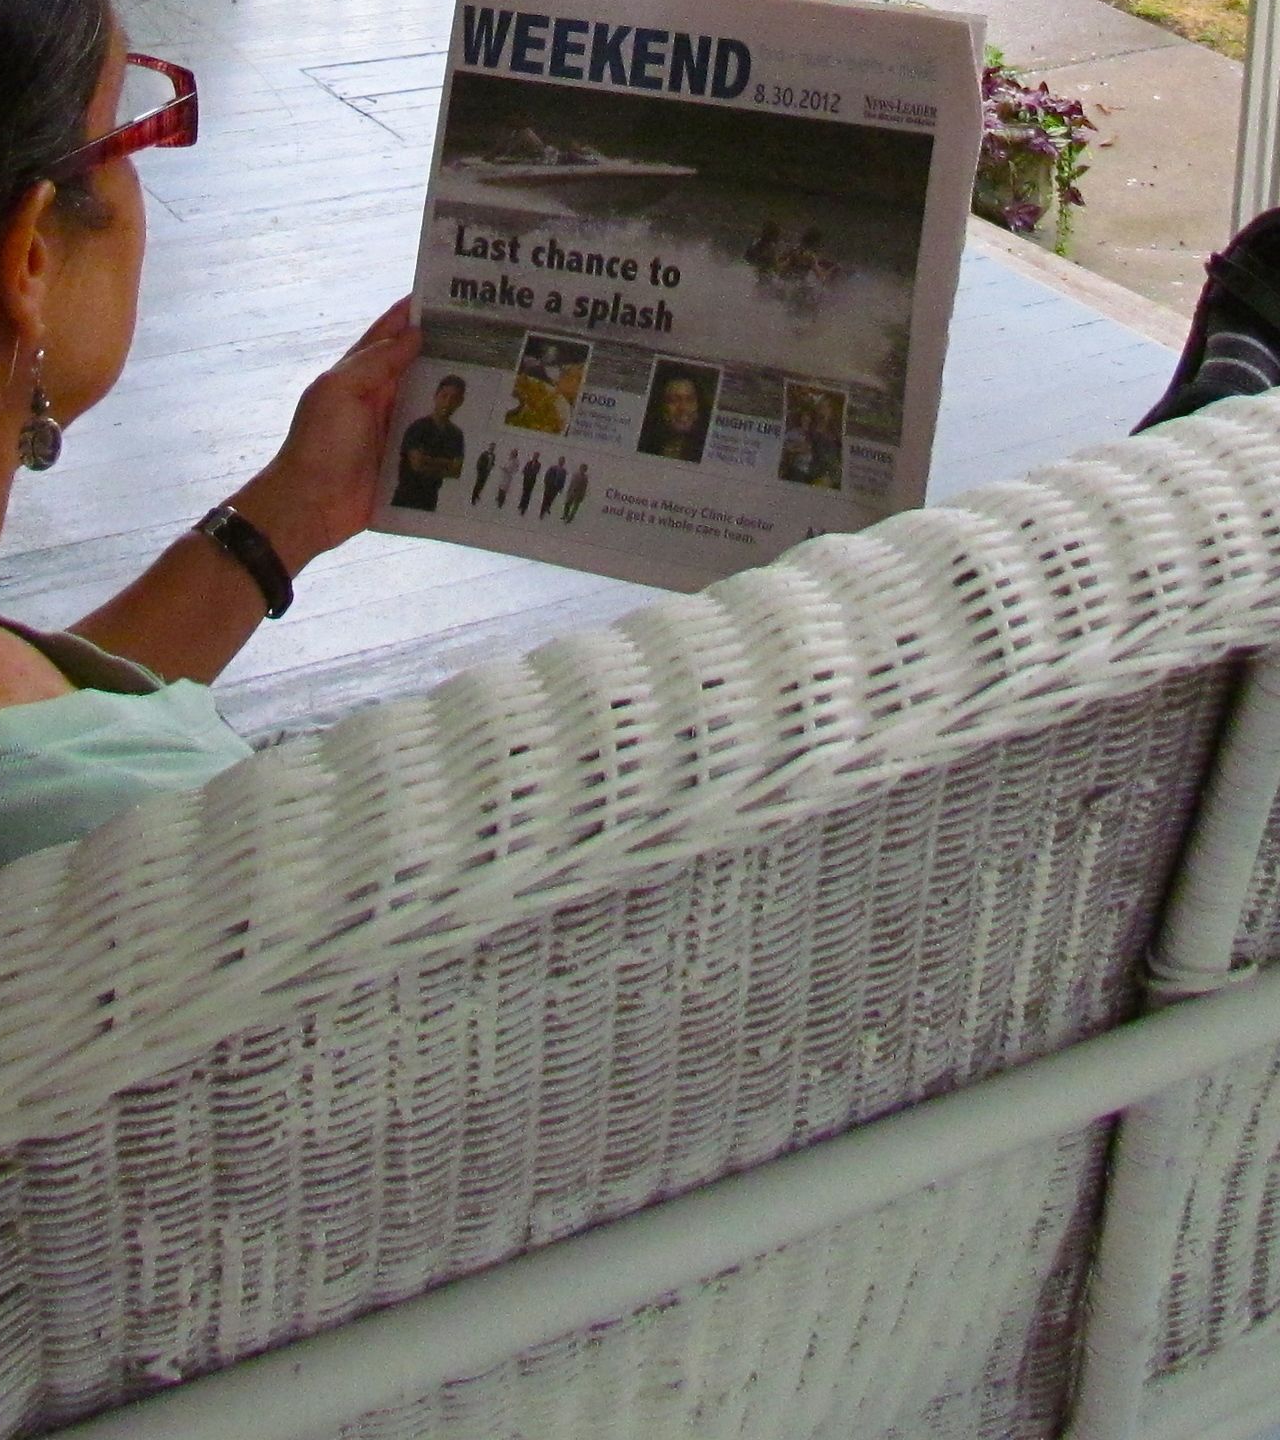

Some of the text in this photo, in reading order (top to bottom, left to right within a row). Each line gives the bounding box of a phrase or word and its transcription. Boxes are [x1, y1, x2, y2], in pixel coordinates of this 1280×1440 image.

[463, 5, 751, 100] WEEKEND
[754, 83, 841, 114] 8.30.2012
[454, 224, 681, 288] Last chance to
[450, 274, 674, 333] make a splash
[581, 392, 616, 408] FOOD
[715, 415, 755, 433] NIGHT
[601, 503, 757, 545] and get a whole care team.
[604, 486, 775, 533] Choose a Mercy Clinic doctor
